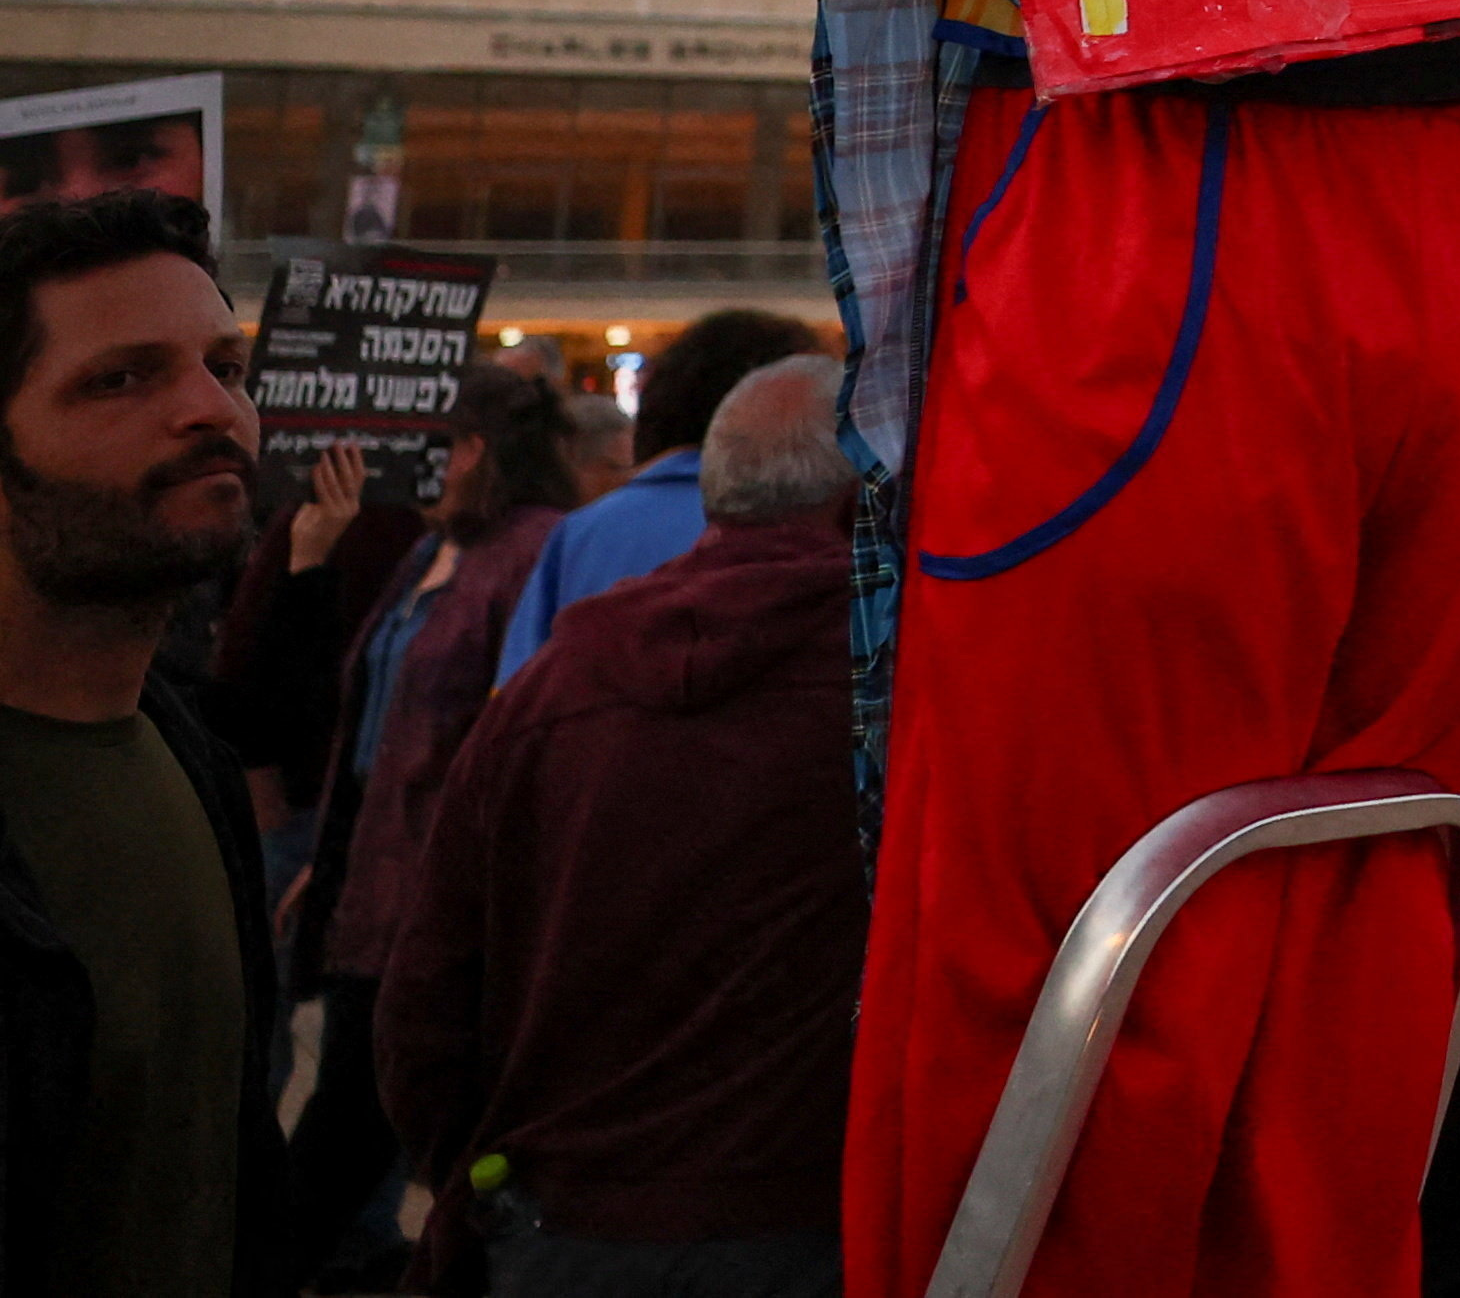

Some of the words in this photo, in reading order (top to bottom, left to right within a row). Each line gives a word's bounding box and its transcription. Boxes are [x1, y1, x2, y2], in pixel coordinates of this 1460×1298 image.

[373, 275, 480, 322] שתיקה
[359, 324, 468, 367] הסכמה
[254, 365, 358, 410] מלחמה
